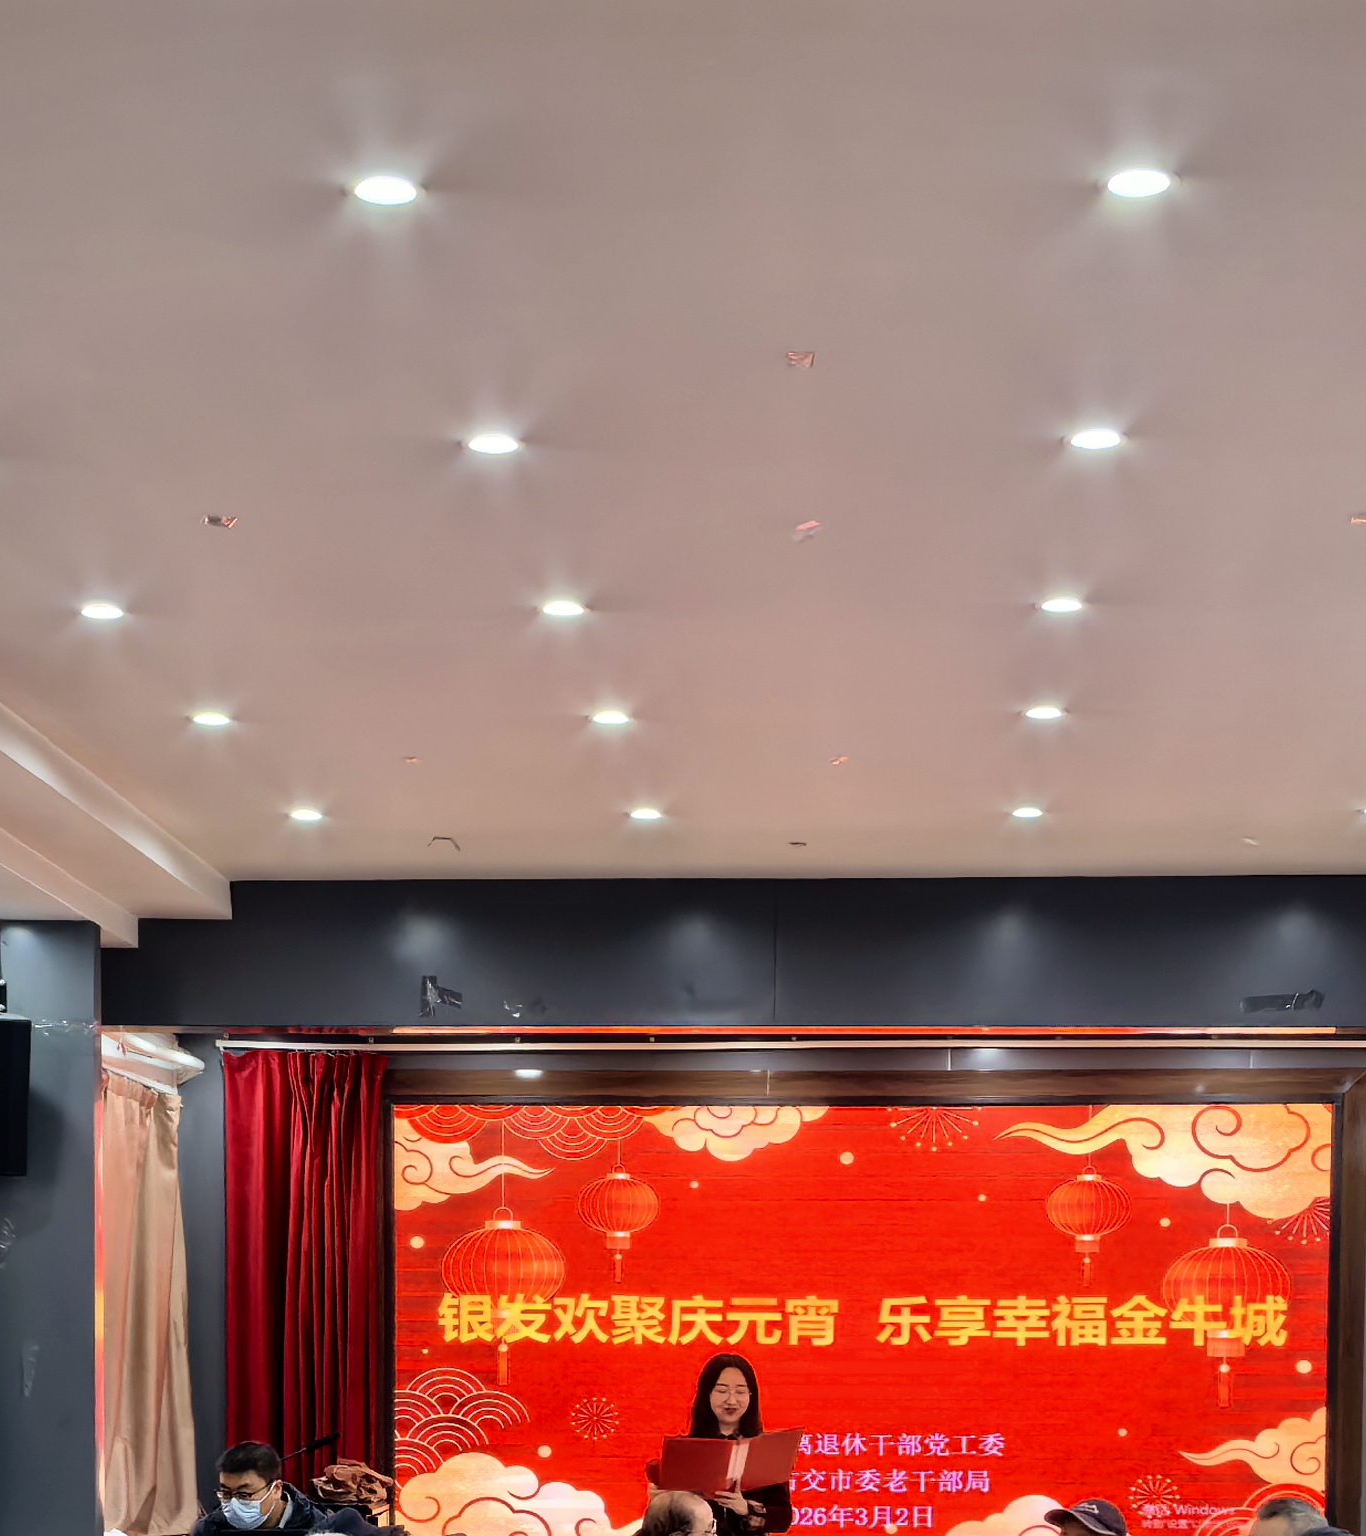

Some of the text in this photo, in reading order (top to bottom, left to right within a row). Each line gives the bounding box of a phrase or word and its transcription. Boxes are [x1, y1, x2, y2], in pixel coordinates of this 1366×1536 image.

[437, 1293, 1289, 1347] 银发欢聚庆元宵 乐享幸福金牛城
[791, 1504, 934, 1529] 026年3月2日
[1175, 1504, 1236, 1516] Windows
